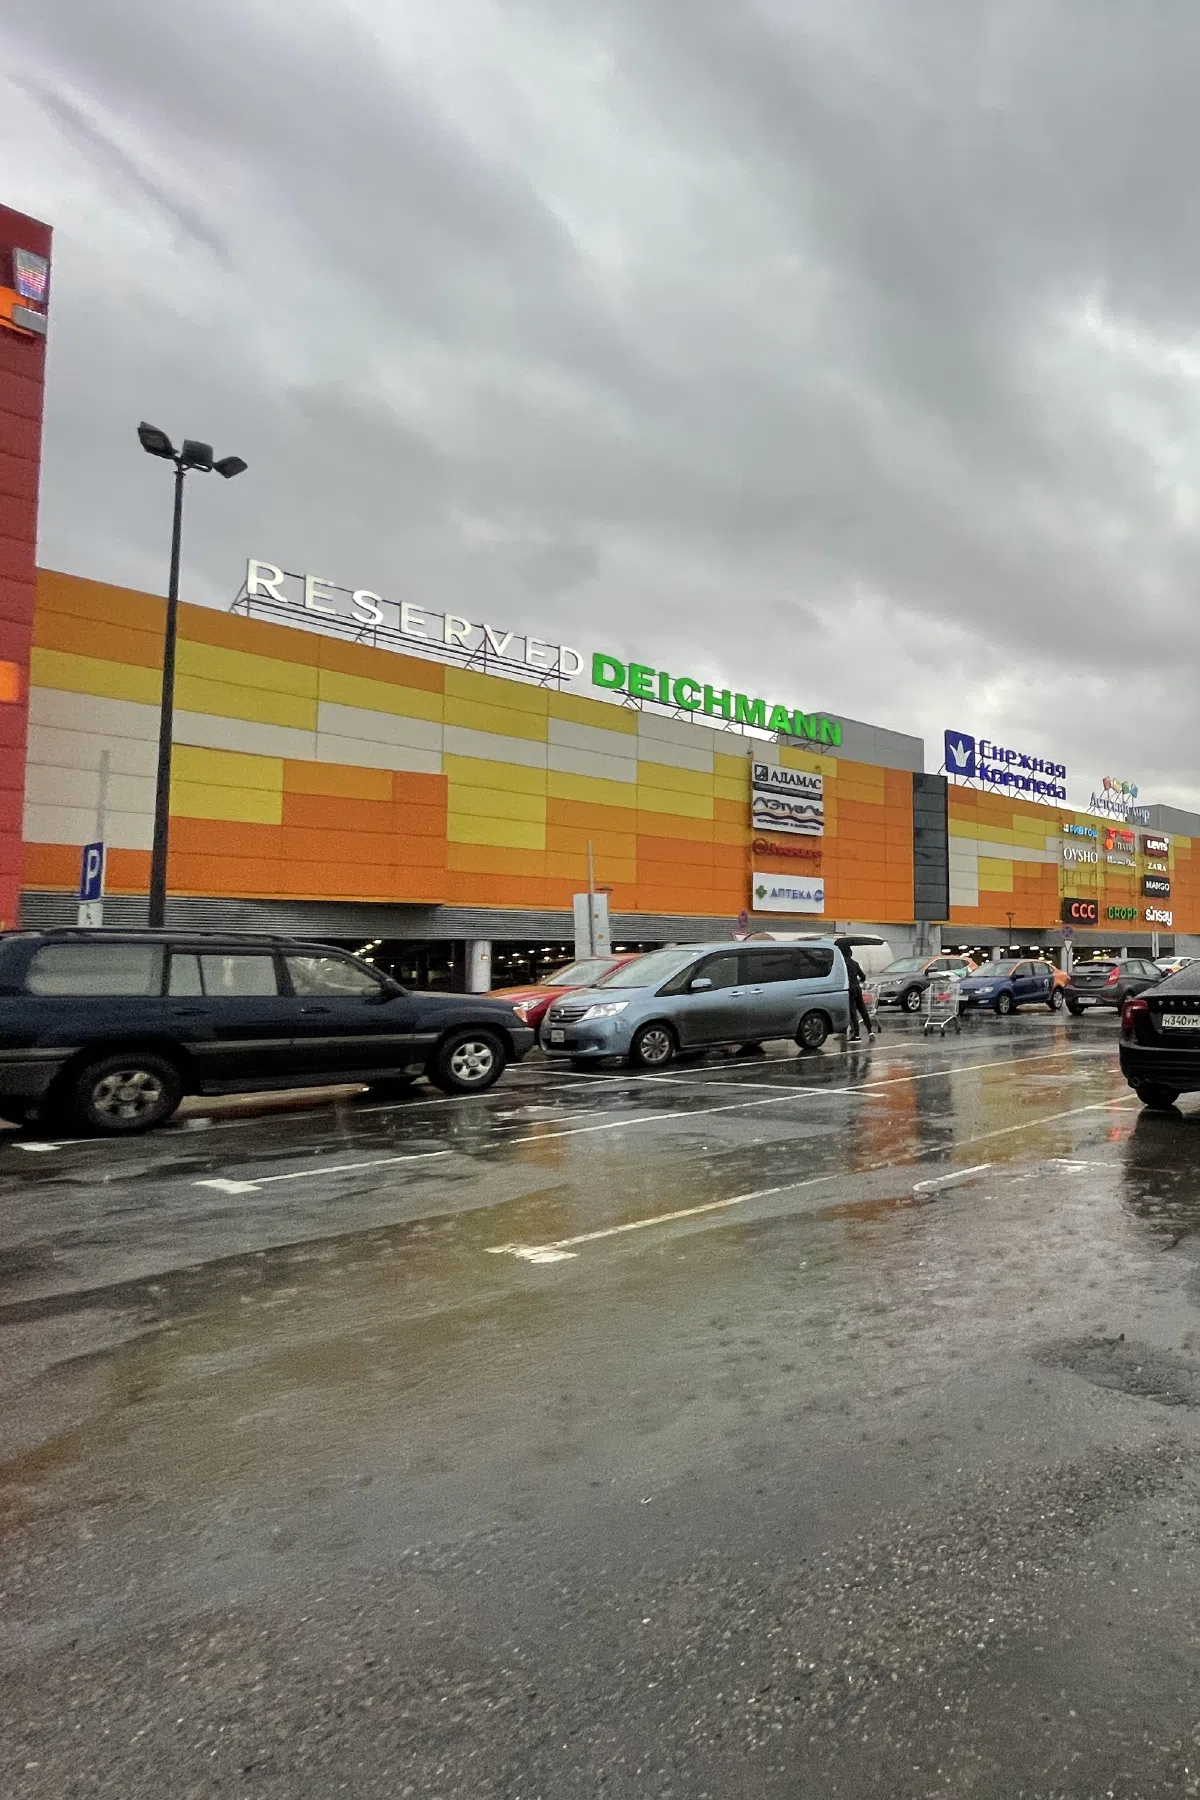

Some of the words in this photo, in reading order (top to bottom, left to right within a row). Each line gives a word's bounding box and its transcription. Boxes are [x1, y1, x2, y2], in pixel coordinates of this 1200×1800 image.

[247, 559, 584, 676] RESERVED
[592, 652, 842, 747] DEICHMANN
[979, 739, 1066, 779] Снежная
[771, 771, 822, 790] АДАМАС
[980, 763, 1067, 800] Королева
[1064, 847, 1098, 864] OYSHO
[85, 849, 100, 895] P
[1147, 862, 1167, 872] ZARA
[770, 887, 812, 900] АПТЕКА
[1146, 881, 1170, 891] MANGO
[1071, 903, 1096, 919] CCC
[1145, 905, 1173, 927] sinsay
